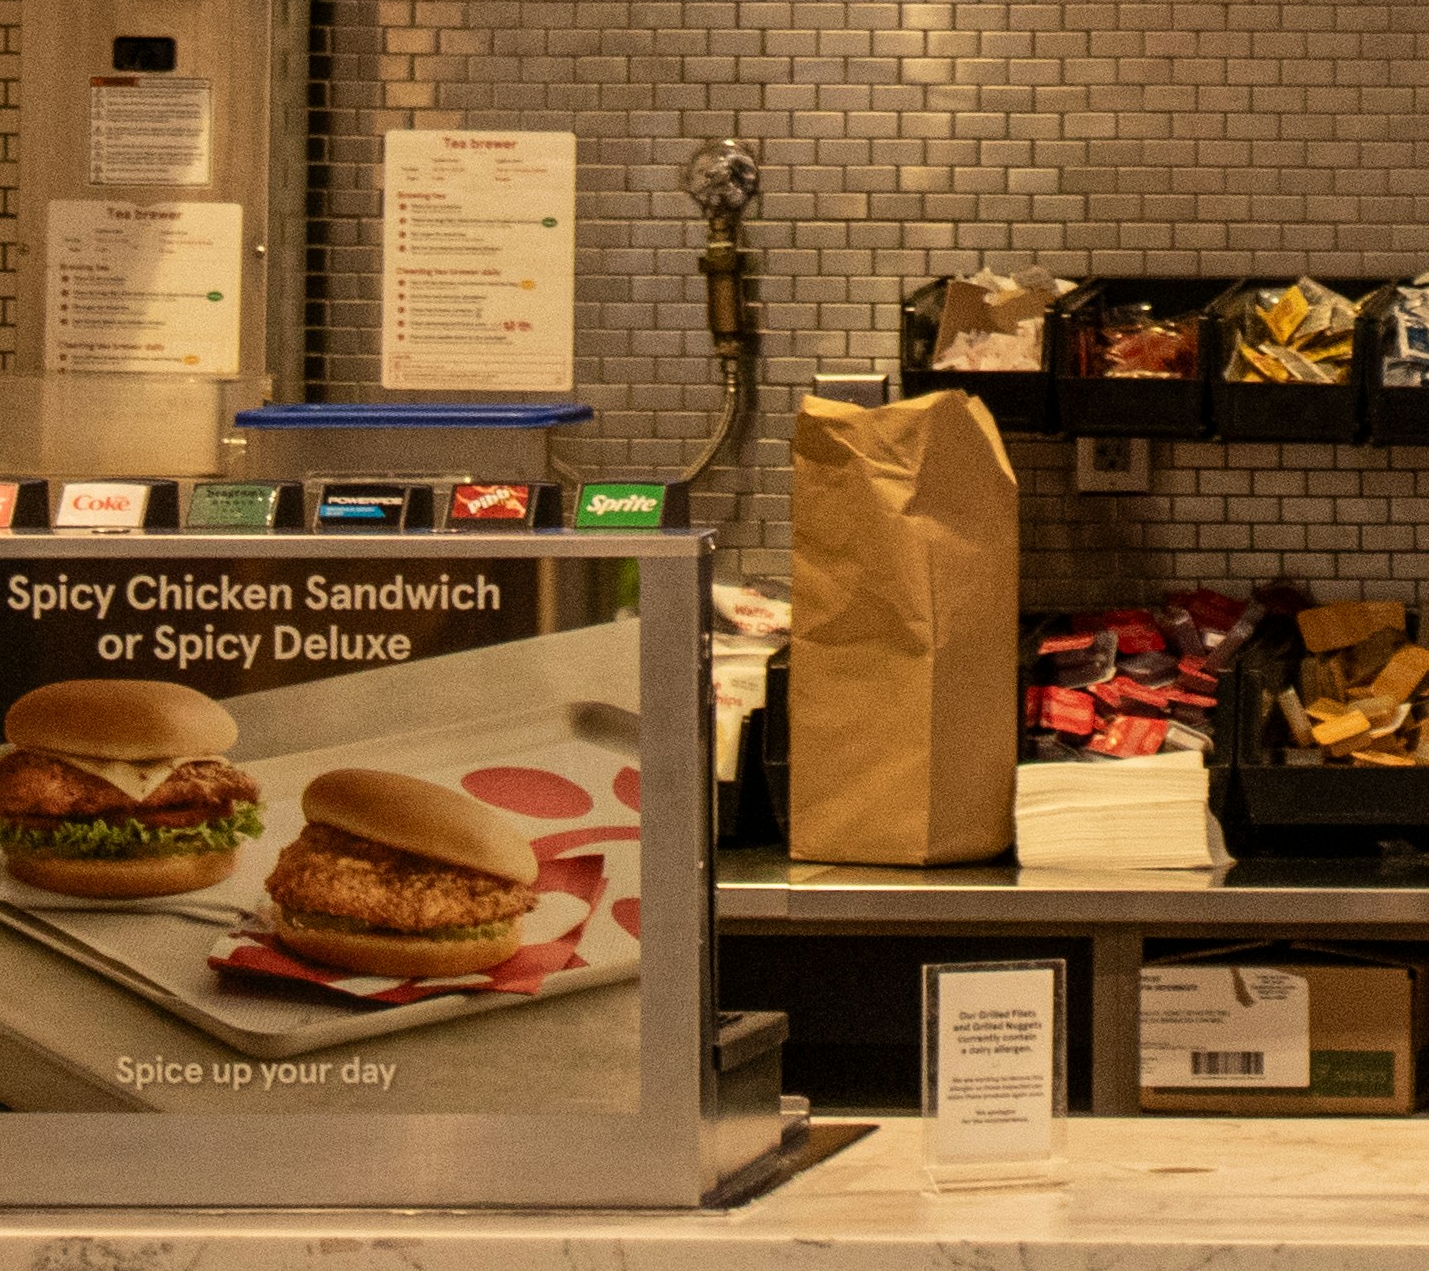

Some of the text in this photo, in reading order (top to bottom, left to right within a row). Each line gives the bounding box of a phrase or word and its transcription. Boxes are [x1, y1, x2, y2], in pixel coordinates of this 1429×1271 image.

[73, 494, 131, 511] Coke
[587, 495, 657, 515] Sprite
[7, 574, 501, 621] Spicy Chicken Sandwich
[97, 625, 411, 671] or Spicy Deluxe
[979, 1011, 1010, 1019] Grilled
[1013, 1010, 1036, 1018] Filets
[973, 1023, 1004, 1031] Grilled
[1006, 1023, 1041, 1031] Nuggets
[958, 1034, 1036, 1044] currently contain
[970, 1047, 991, 1056] dairy
[994, 1046, 1032, 1054] allergen.
[115, 1056, 397, 1094] Spice up your day
